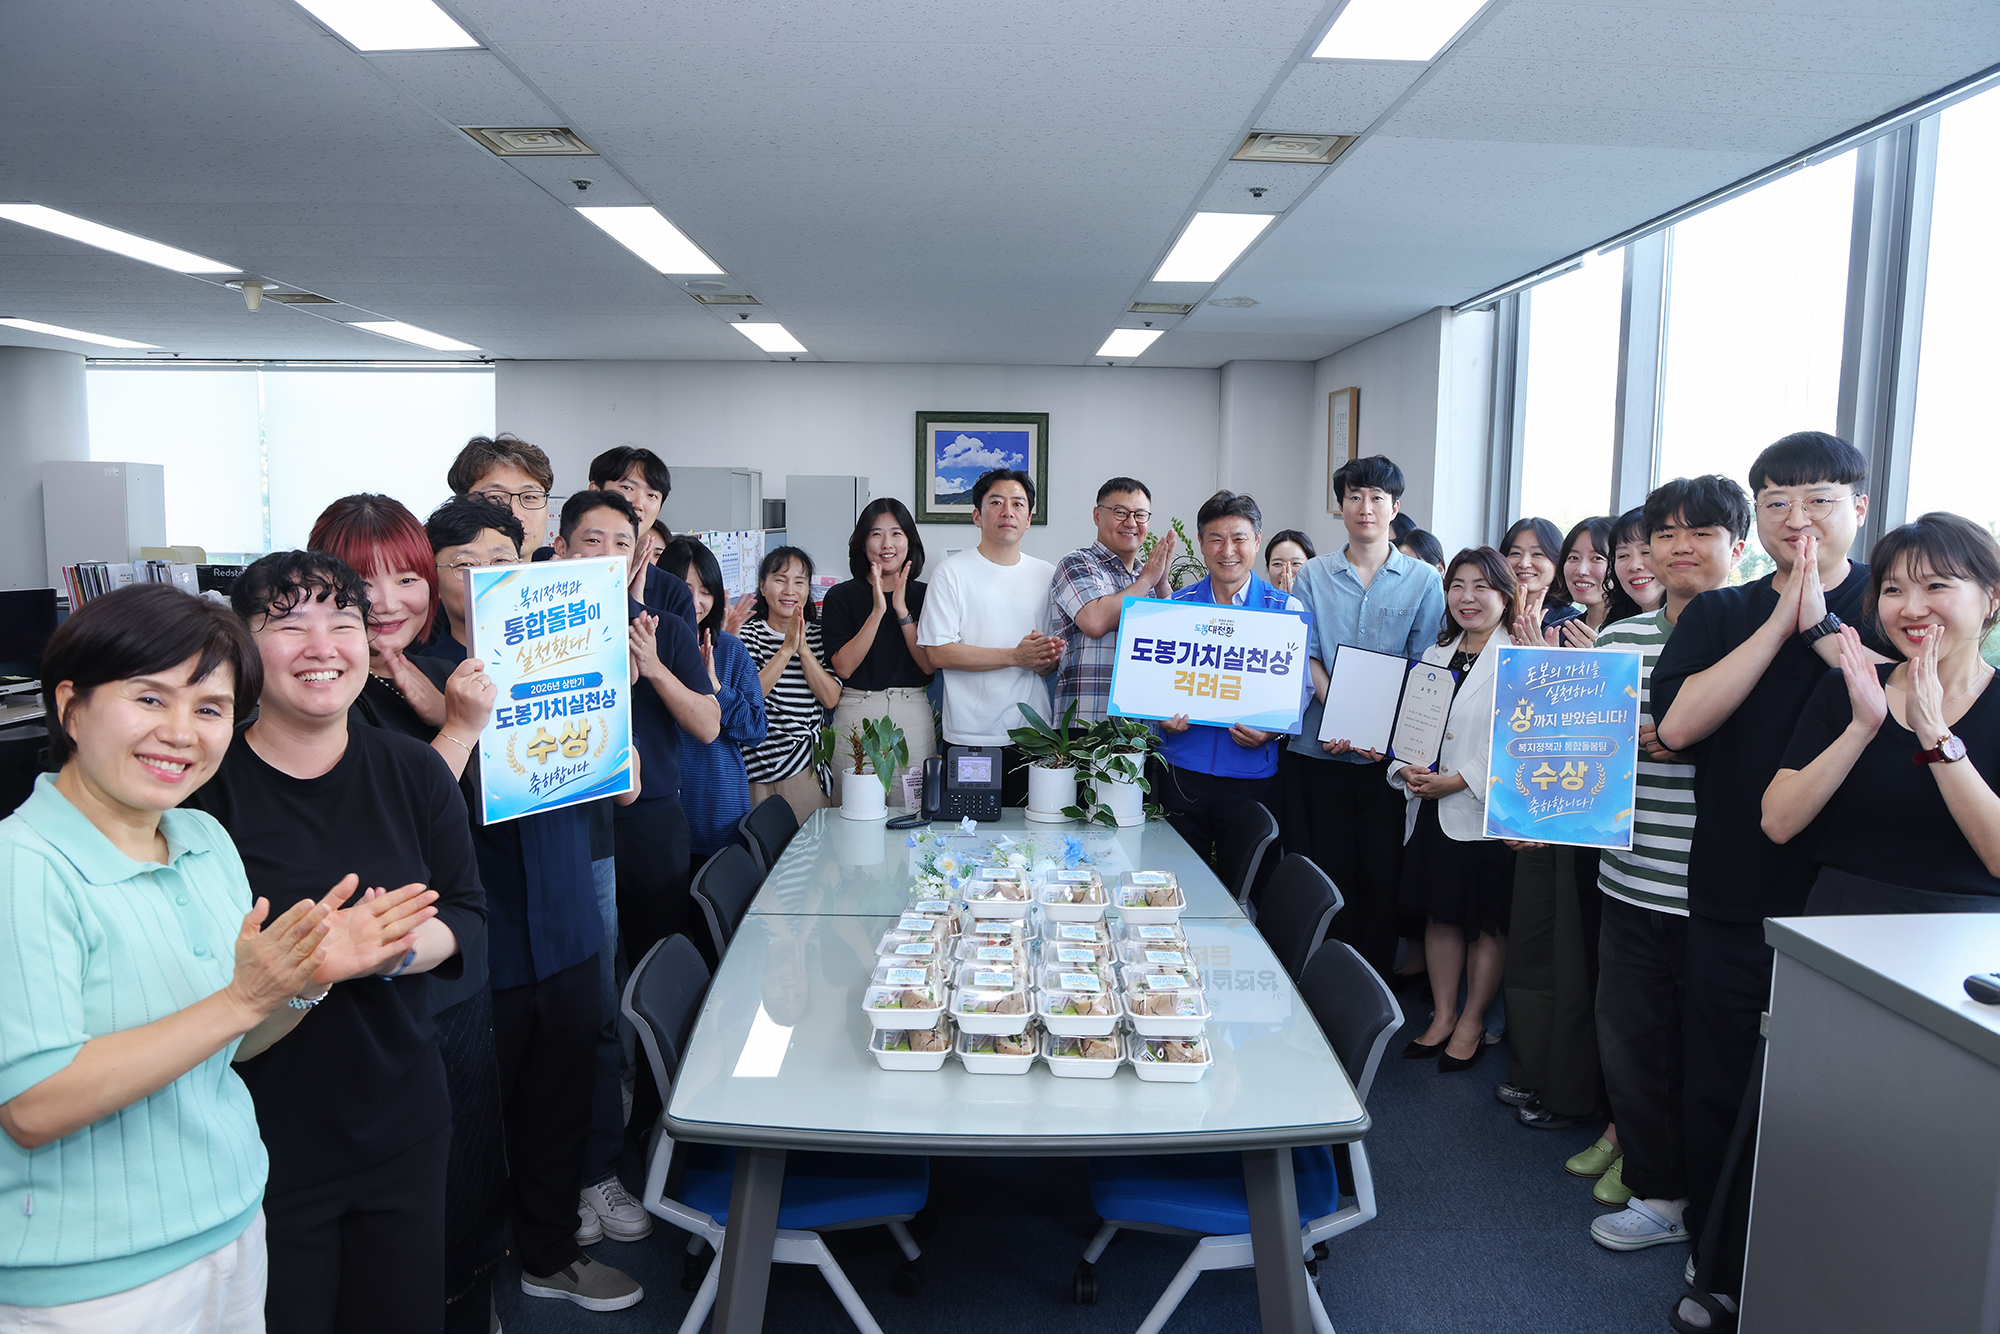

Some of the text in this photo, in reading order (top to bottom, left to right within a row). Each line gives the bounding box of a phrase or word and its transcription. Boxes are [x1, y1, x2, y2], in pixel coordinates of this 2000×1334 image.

[519, 579, 582, 609] 복지정책과
[503, 599, 601, 646] 통합돌봄이
[516, 628, 591, 673] 실천했다!
[1131, 638, 1293, 675] 도봉가치실천상
[530, 677, 585, 695] 2026년 상반기
[1174, 670, 1242, 700] 격려금
[1525, 661, 1601, 685] 도봉의 가치를
[1545, 681, 1606, 705] 실천하니!
[495, 688, 617, 730] 도봉가치실천상
[1561, 710, 1628, 726] 받았습니다!
[526, 718, 591, 764] 수상
[1518, 741, 1607, 753] 복지정책과 통합돌봄팀
[528, 760, 590, 796] 축하합니다
[1531, 761, 1589, 790] 수상
[1527, 796, 1595, 817] 축하합니다!
